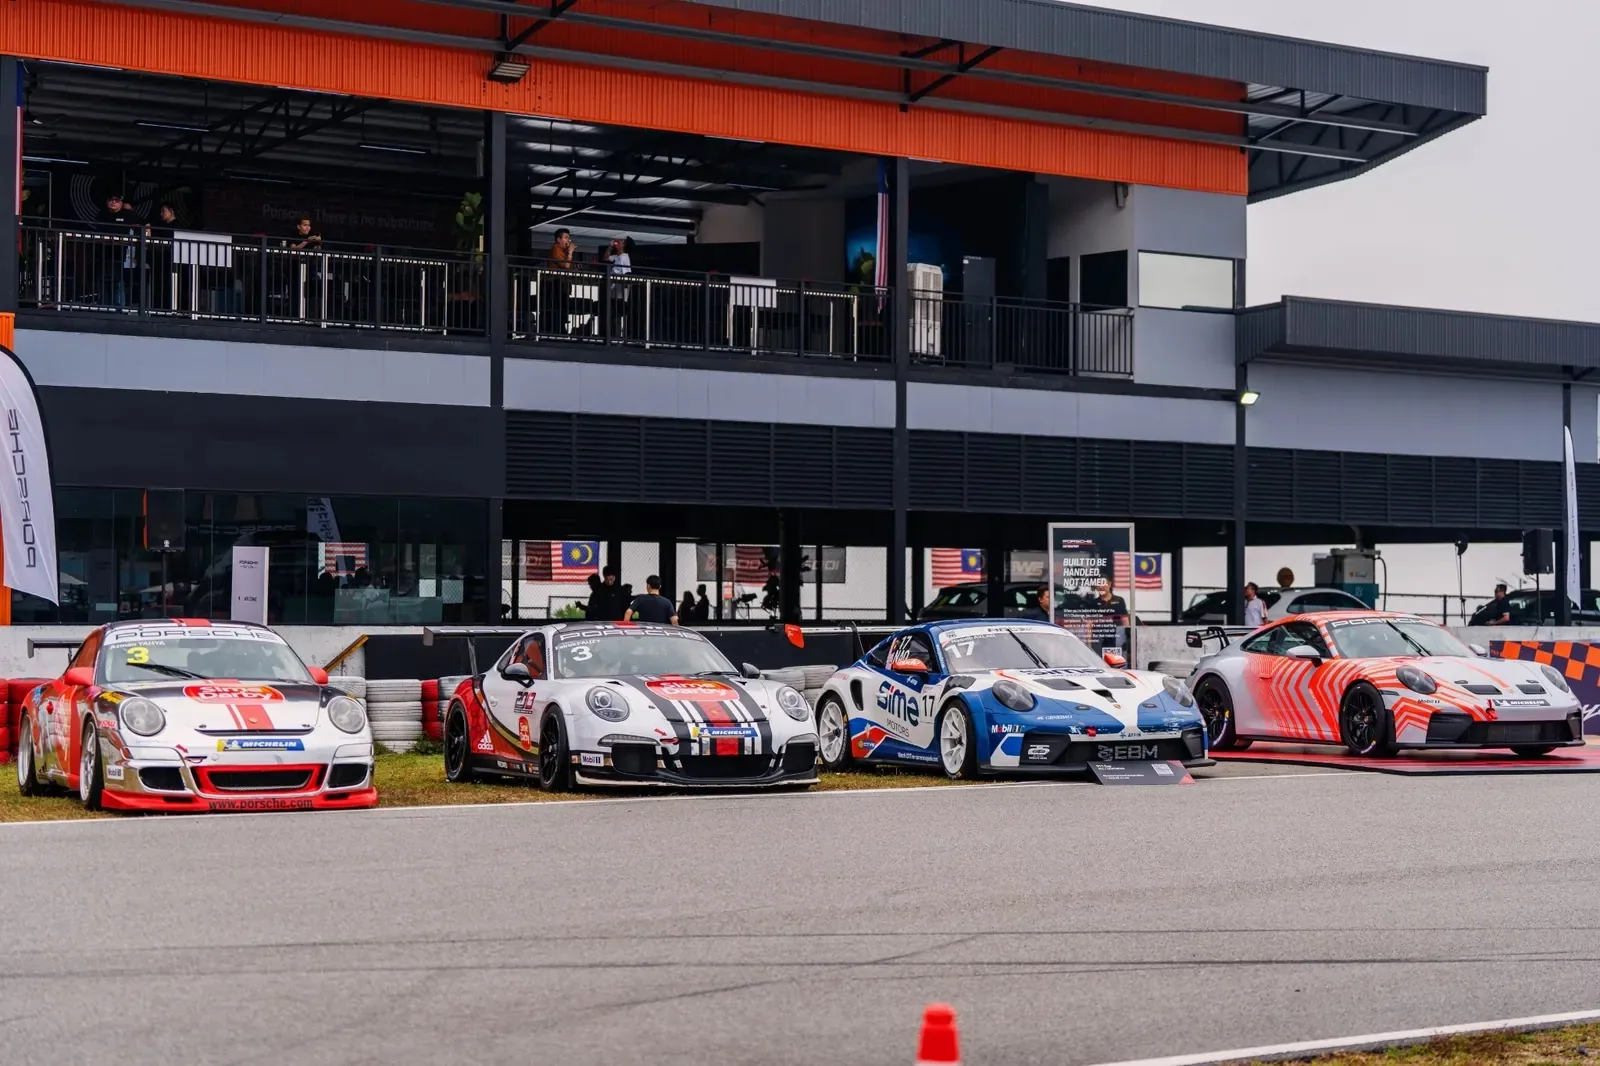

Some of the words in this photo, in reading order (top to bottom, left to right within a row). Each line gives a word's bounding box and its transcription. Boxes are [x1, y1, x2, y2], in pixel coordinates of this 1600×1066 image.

[1063, 558, 1085, 566] BUILT
[1086, 558, 1096, 566] TO
[1097, 558, 1107, 566] BE
[1063, 568, 1101, 577] HANDLED,
[1063, 578, 1080, 586] NOT
[1081, 578, 1109, 586] TAMED.
[1331, 616, 1437, 628] PORSCHE
[116, 630, 277, 641] PORSCHE
[560, 629, 703, 641] PORSCHE
[899, 636, 913, 649] 17
[127, 647, 149, 663] 3
[570, 646, 593, 661] 3
[945, 641, 975, 659] 17
[198, 691, 272, 700] Darby
[661, 687, 726, 696] Darby
[877, 681, 920, 727] Sime
[922, 695, 935, 717] 17
[886, 718, 910, 737] MOTORS
[991, 725, 1010, 733] Mobil
[477, 743, 494, 751] adidas
[1115, 745, 1158, 760] EBM
[582, 755, 595, 763] Mobil
[208, 799, 313, 810] www.porsche.com
